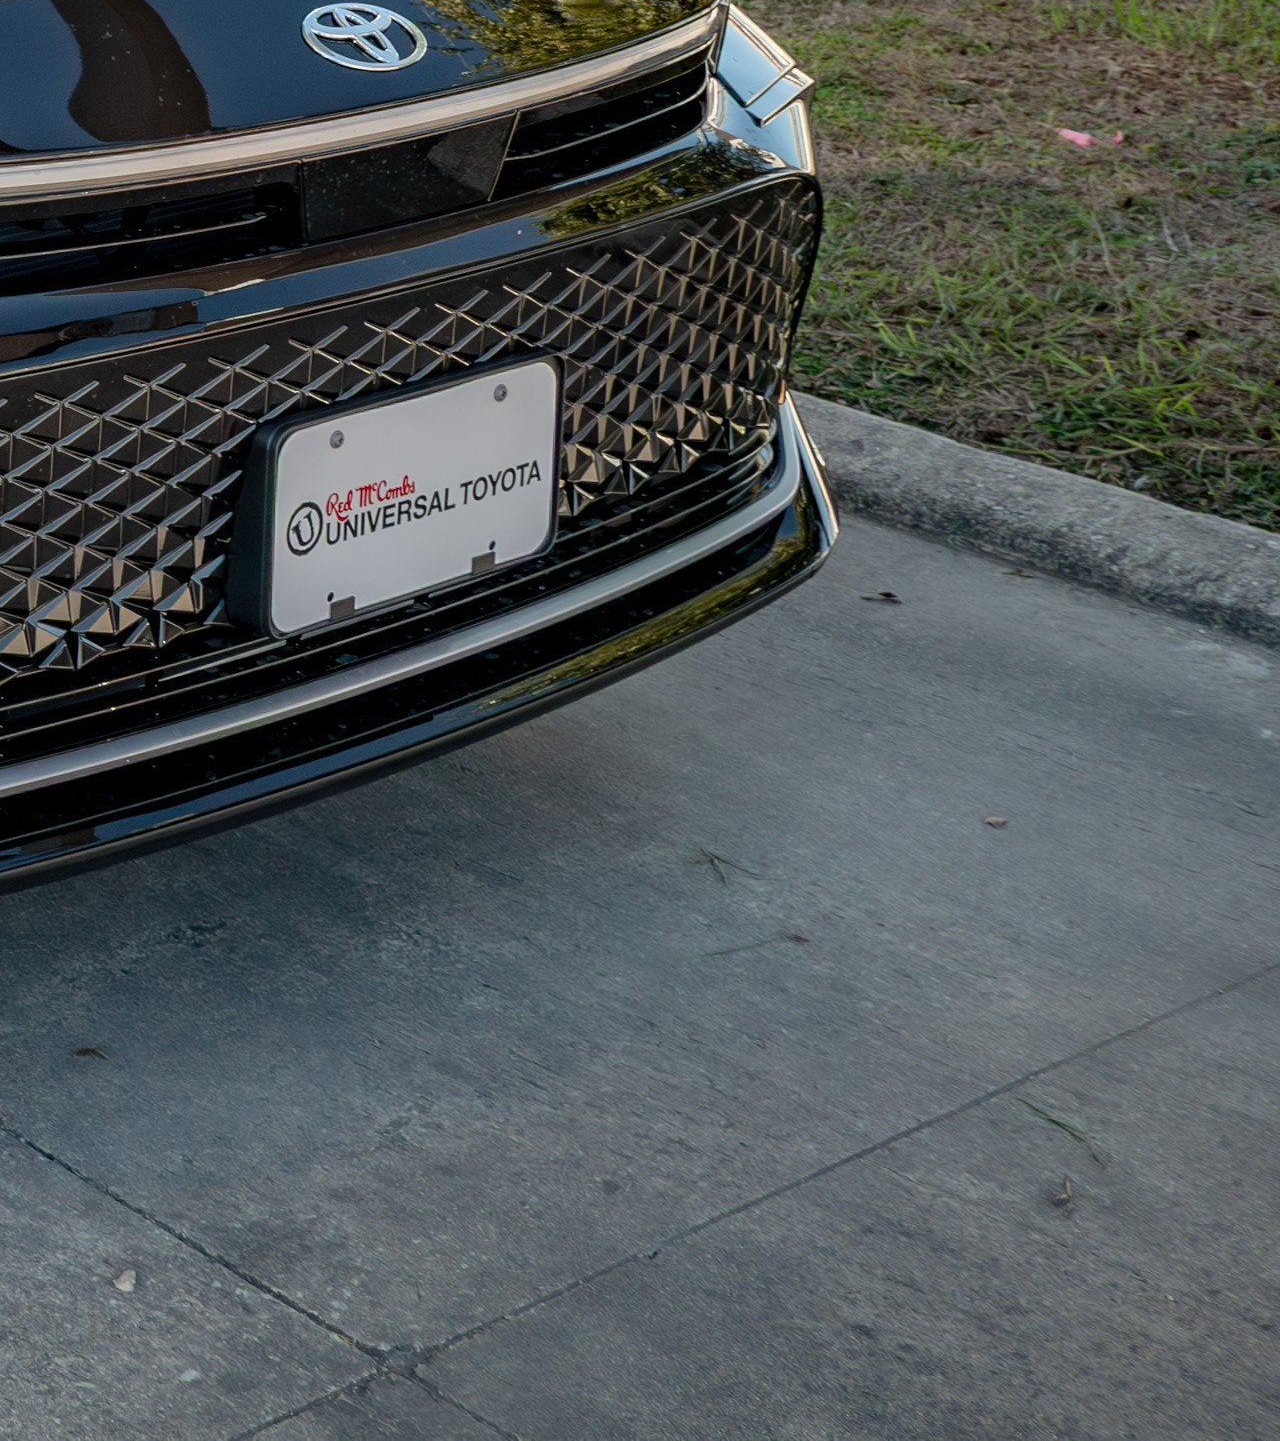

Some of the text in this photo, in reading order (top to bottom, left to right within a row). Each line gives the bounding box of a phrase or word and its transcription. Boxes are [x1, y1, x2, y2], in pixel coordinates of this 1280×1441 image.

[326, 475, 416, 522] Red McCombs
[326, 460, 542, 545] UNIVERSAL TOYOTA
